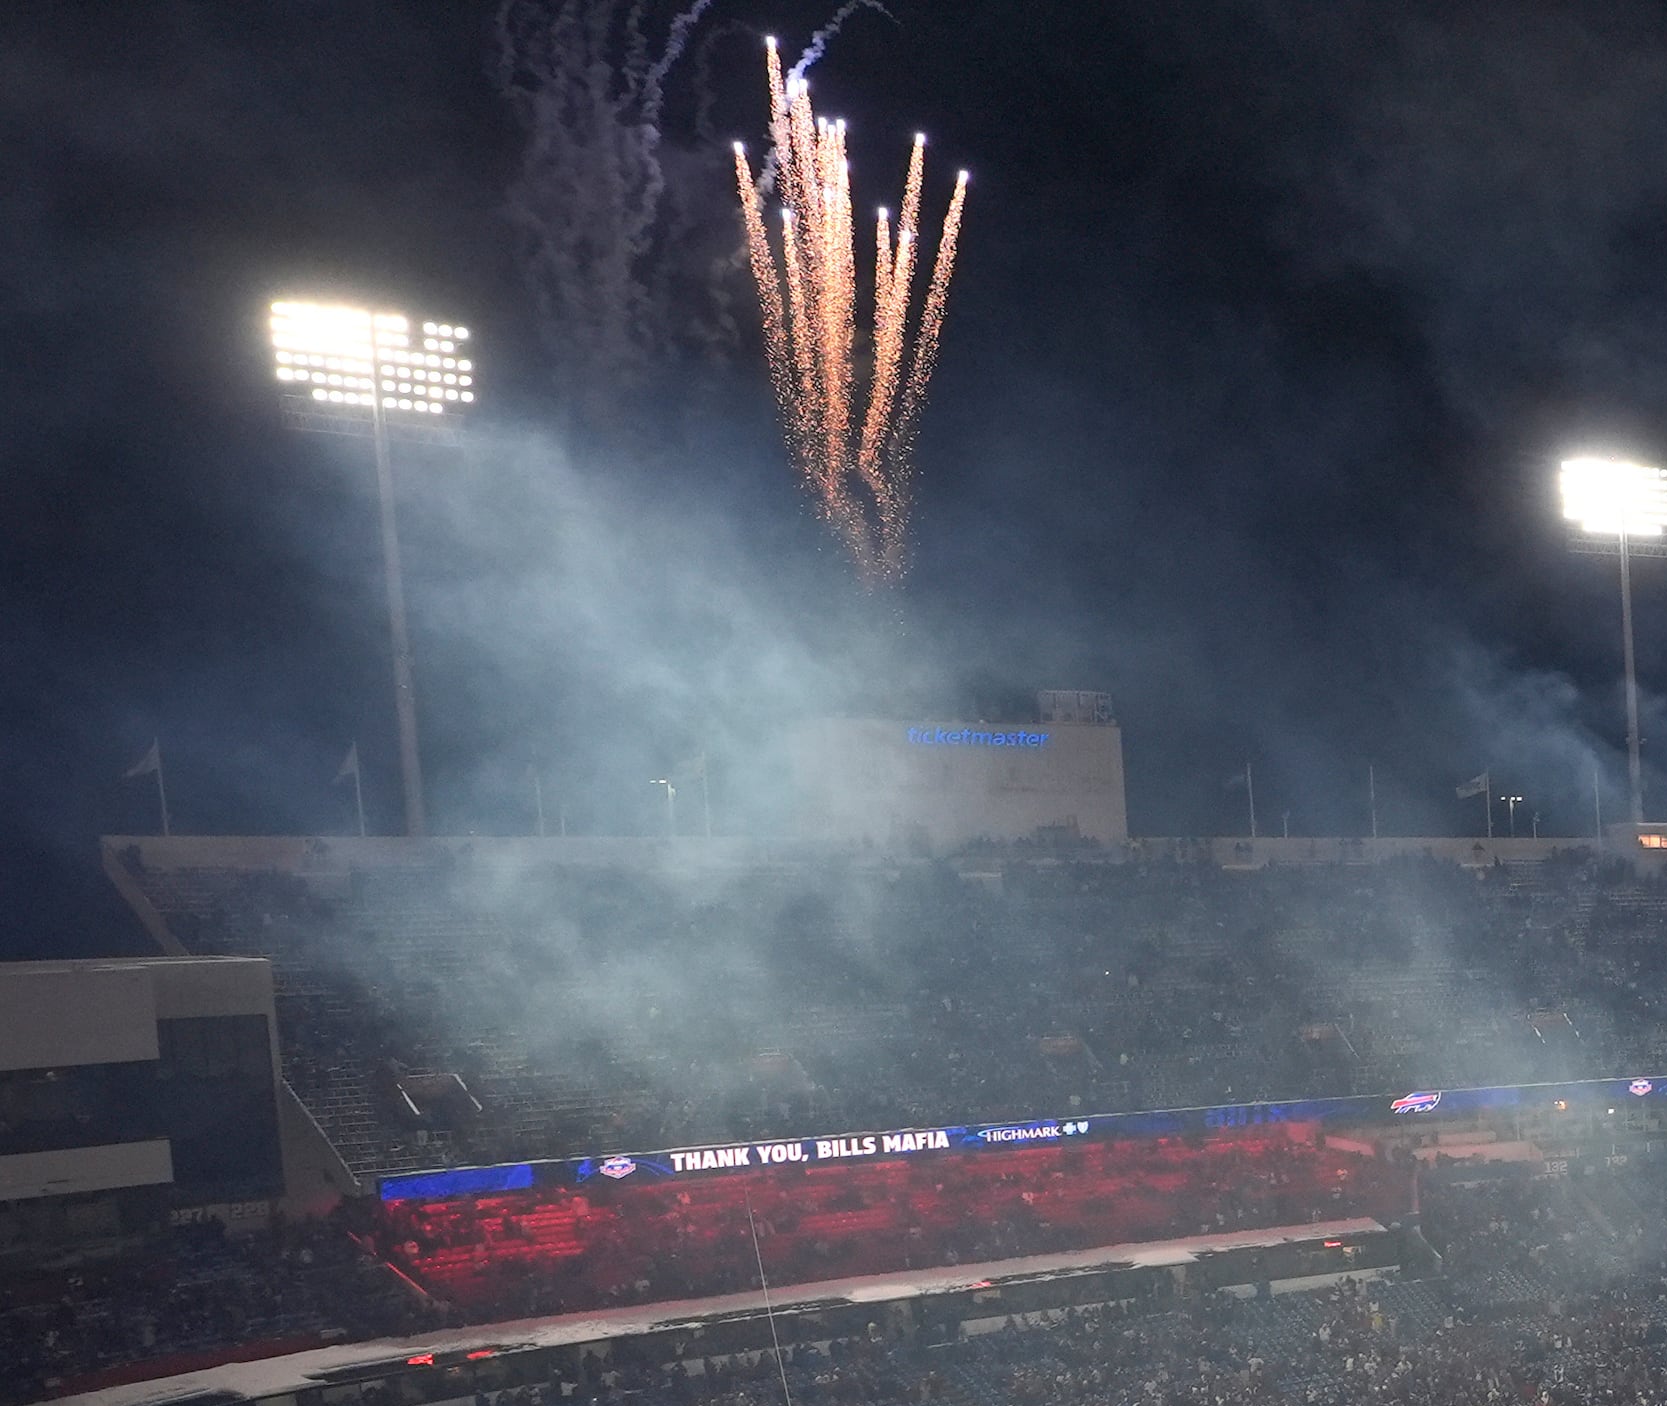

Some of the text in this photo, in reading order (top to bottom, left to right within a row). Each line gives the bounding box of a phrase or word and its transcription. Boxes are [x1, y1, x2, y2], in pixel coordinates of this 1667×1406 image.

[907, 726, 1049, 748] ticketmaster
[670, 1123, 1061, 1172] THANK YOU, BILLS MAFIA HIGHMARK
[1544, 1161, 1567, 1174] 132
